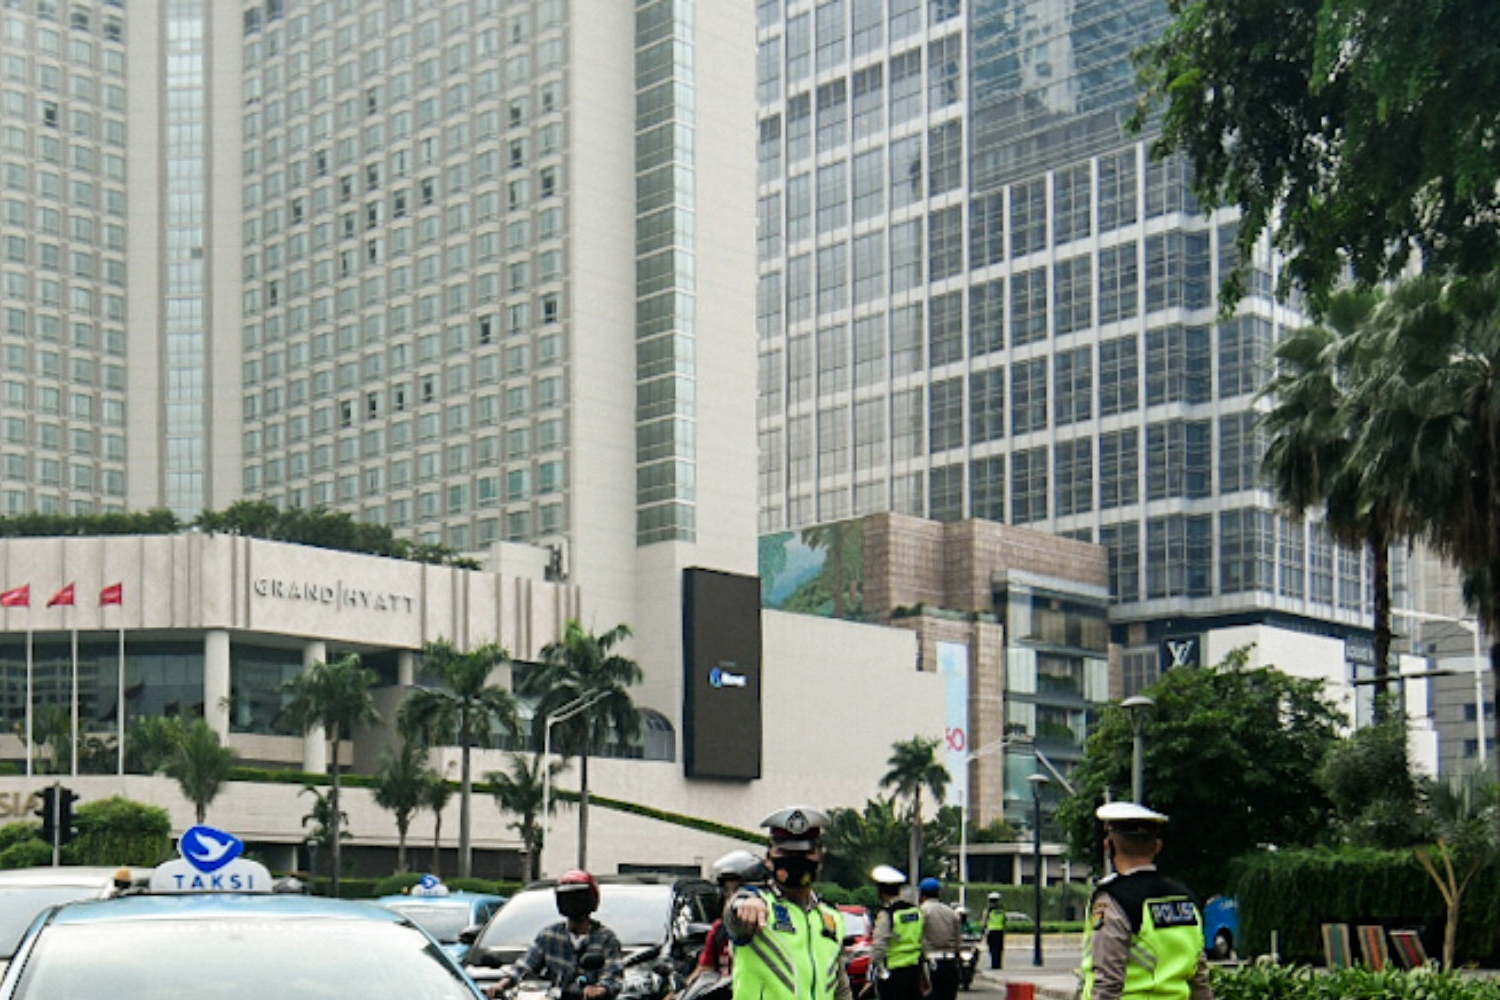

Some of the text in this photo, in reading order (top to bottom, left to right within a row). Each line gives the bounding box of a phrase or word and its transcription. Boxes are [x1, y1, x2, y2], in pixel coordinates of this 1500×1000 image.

[254, 578, 416, 613] GRAND HYATT
[173, 875, 253, 889] TAKSI
